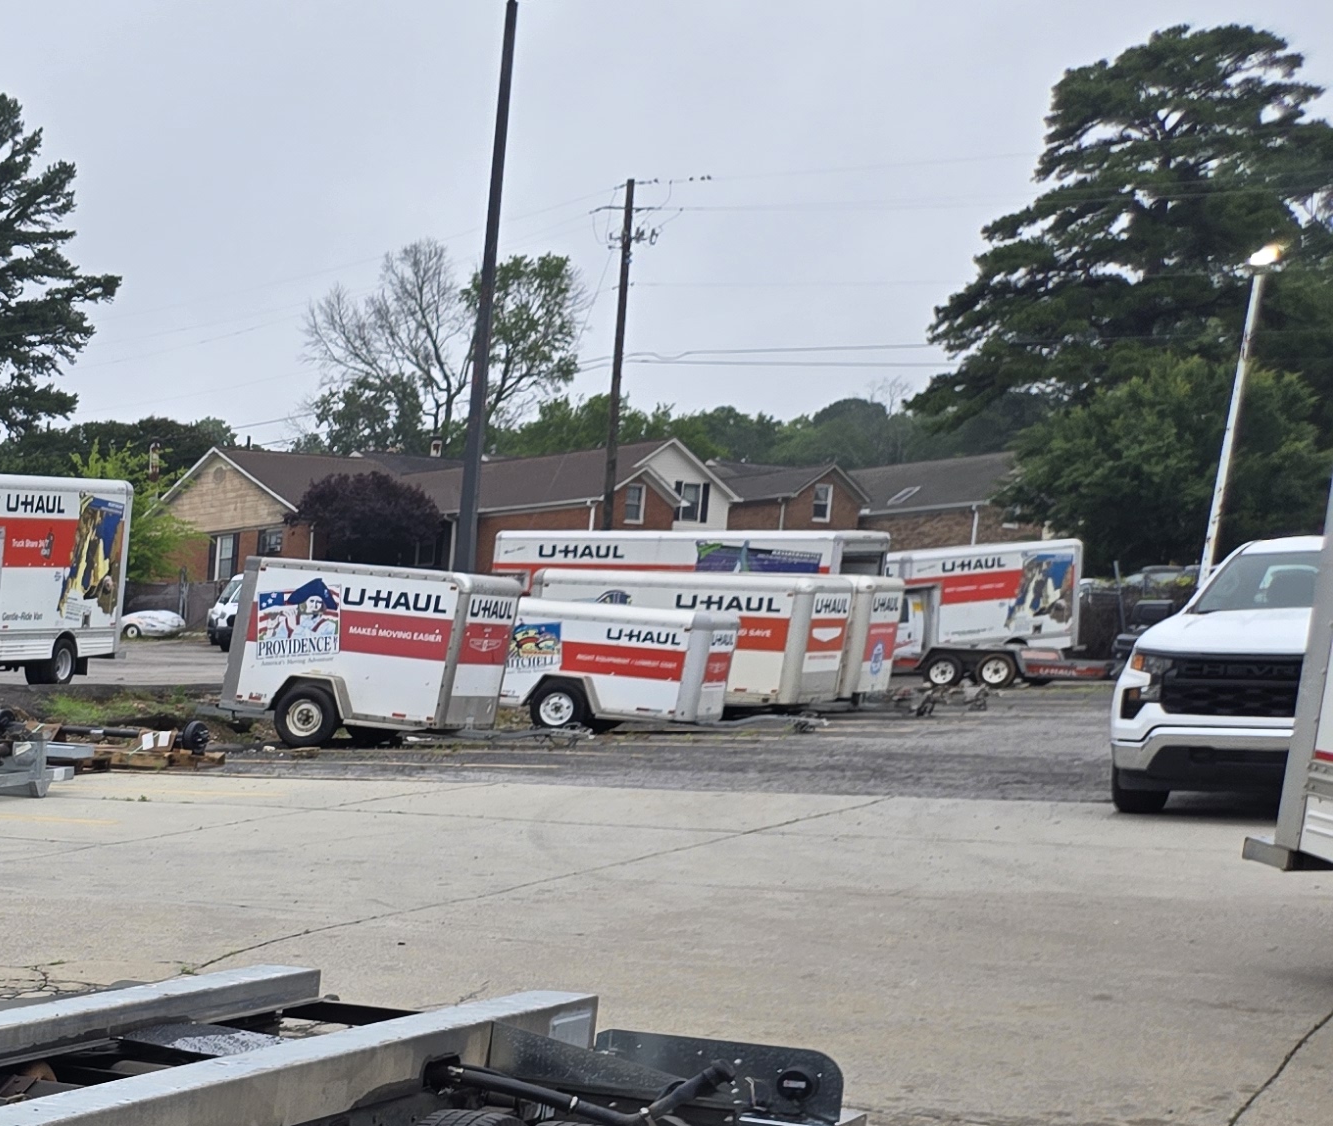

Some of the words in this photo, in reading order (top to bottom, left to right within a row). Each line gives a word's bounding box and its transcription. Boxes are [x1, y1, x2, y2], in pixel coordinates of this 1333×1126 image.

[6, 494, 65, 514] U-HAUL
[538, 544, 625, 559] U-HAUL
[941, 557, 1006, 573] U-HAUL
[343, 587, 447, 614] U-HAUL
[470, 598, 512, 620] U-HAUL
[675, 593, 781, 613] U-HAUL
[814, 598, 848, 614] U-HAUL
[873, 596, 899, 613] U-HAUL
[349, 626, 377, 636] MAKES
[378, 629, 412, 641] MOVING
[413, 632, 442, 643] EASIER
[606, 627, 681, 646] U-HAUL
[258, 636, 332, 656] PROVIDENCE
[1183, 663, 1297, 677] CHEVR
